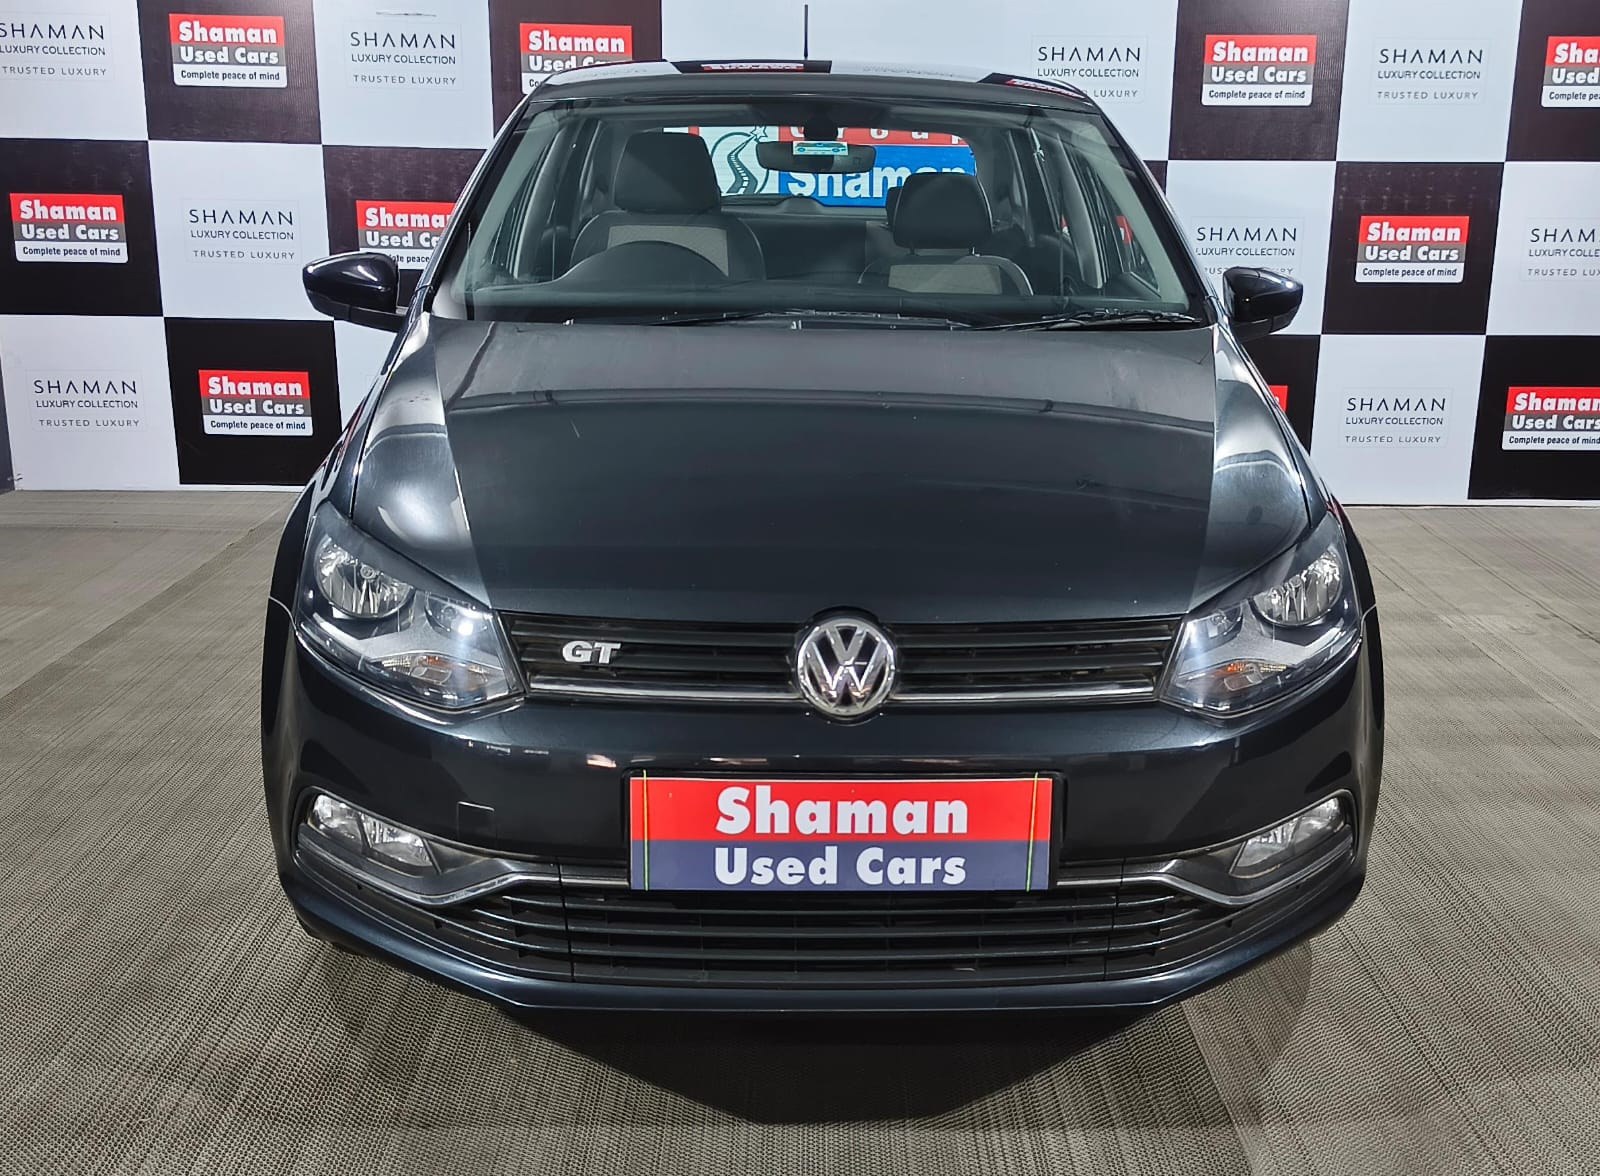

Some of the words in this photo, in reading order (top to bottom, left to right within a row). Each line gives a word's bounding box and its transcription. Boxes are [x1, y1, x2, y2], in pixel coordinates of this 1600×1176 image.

[0, 22, 105, 40] SHAMAN
[178, 20, 278, 44] Shaman
[350, 31, 456, 49] SHAMAN
[528, 29, 626, 53] Shaman
[42, 46, 106, 56] COLLECTION
[180, 46, 230, 63] Used
[234, 46, 279, 64] Cars
[1037, 46, 1142, 62] SHAMAN
[1212, 40, 1309, 63] Shaman
[1378, 48, 1483, 64] SHAMAN
[1554, 42, 1600, 64] Sha
[351, 54, 392, 63] LUXURY
[394, 54, 456, 65] COLLECTION
[529, 55, 577, 72] Used
[3, 66, 56, 76] TRUSTED
[61, 68, 107, 76] LUXURY
[181, 70, 220, 79] Complete
[222, 71, 247, 81] peace
[249, 71, 257, 80] of
[259, 72, 280, 81] mind
[1037, 68, 1076, 77] LUXURY
[1078, 68, 1139, 78] COLLECTION
[1211, 66, 1259, 83] Used
[1264, 66, 1307, 83] Cars
[1377, 70, 1418, 79] LUXURY
[1419, 70, 1481, 80] COLLECTION
[1552, 67, 1600, 84] Used
[353, 74, 406, 84] TRUSTED
[411, 76, 456, 86] LUXURY
[1093, 89, 1138, 98] LUXURY
[1208, 89, 1247, 99] Complete
[1248, 91, 1272, 100] peace
[1274, 90, 1283, 99] of
[1284, 90, 1306, 99] mind
[1377, 91, 1429, 100] TRUSTED
[1433, 91, 1479, 100] LUXURY
[1549, 92, 1587, 101] Complete
[20, 199, 117, 221] Shaman
[189, 209, 293, 226] SHAMAN
[21, 223, 70, 239] Used
[75, 224, 119, 241] Cars
[191, 230, 231, 239] LUXURY
[232, 230, 294, 240] COLLECTION
[366, 231, 414, 247] Used
[1196, 227, 1297, 242] SHAMAN
[1367, 222, 1461, 242] Shaman
[1530, 228, 1600, 243] SHAM
[22, 246, 61, 256] Complete
[63, 247, 88, 257] peace
[89, 248, 98, 256] of
[100, 247, 121, 256] mind
[193, 250, 245, 259] TRUSTED
[250, 251, 295, 260] LUXURY
[1195, 247, 1235, 256] LUXURY
[1235, 247, 1296, 257] COLLECTION
[1365, 245, 1412, 261] Used
[1417, 246, 1459, 261] Cars
[1528, 248, 1568, 257] LUXURY
[1362, 268, 1400, 277] Complete
[1401, 269, 1425, 277] peace
[1426, 268, 1436, 276] of
[1437, 268, 1458, 277] mind
[1527, 268, 1578, 277] TRUSTED
[33, 380, 137, 395] SHAMAN
[208, 376, 303, 396] Shaman
[36, 400, 75, 408] LUXURY
[77, 400, 139, 409] COLLECTION
[209, 398, 257, 414] Used
[261, 399, 305, 415] Cars
[1346, 397, 1446, 412] SHAMAN
[1513, 392, 1600, 412] Shaman
[39, 419, 91, 427] TRUSTED
[95, 419, 140, 427] LUXURY
[210, 420, 248, 430] Complete
[250, 421, 274, 430] peace
[275, 421, 284, 429] of
[285, 421, 306, 430] mind
[1345, 416, 1385, 425] LUXURY
[1385, 416, 1444, 426] COLLECTION
[1511, 414, 1558, 430] Used
[1562, 414, 1600, 430] Cars
[1344, 435, 1393, 443] TRUSTED
[1398, 435, 1441, 443] LUXURY
[1509, 435, 1545, 445] Complete
[1546, 436, 1570, 445] peace
[1571, 436, 1580, 444] of
[1581, 436, 1600, 444] mind
[562, 640, 621, 665] GT
[715, 785, 969, 835] Shaman
[714, 845, 839, 886] Used
[855, 847, 967, 886] Cars
